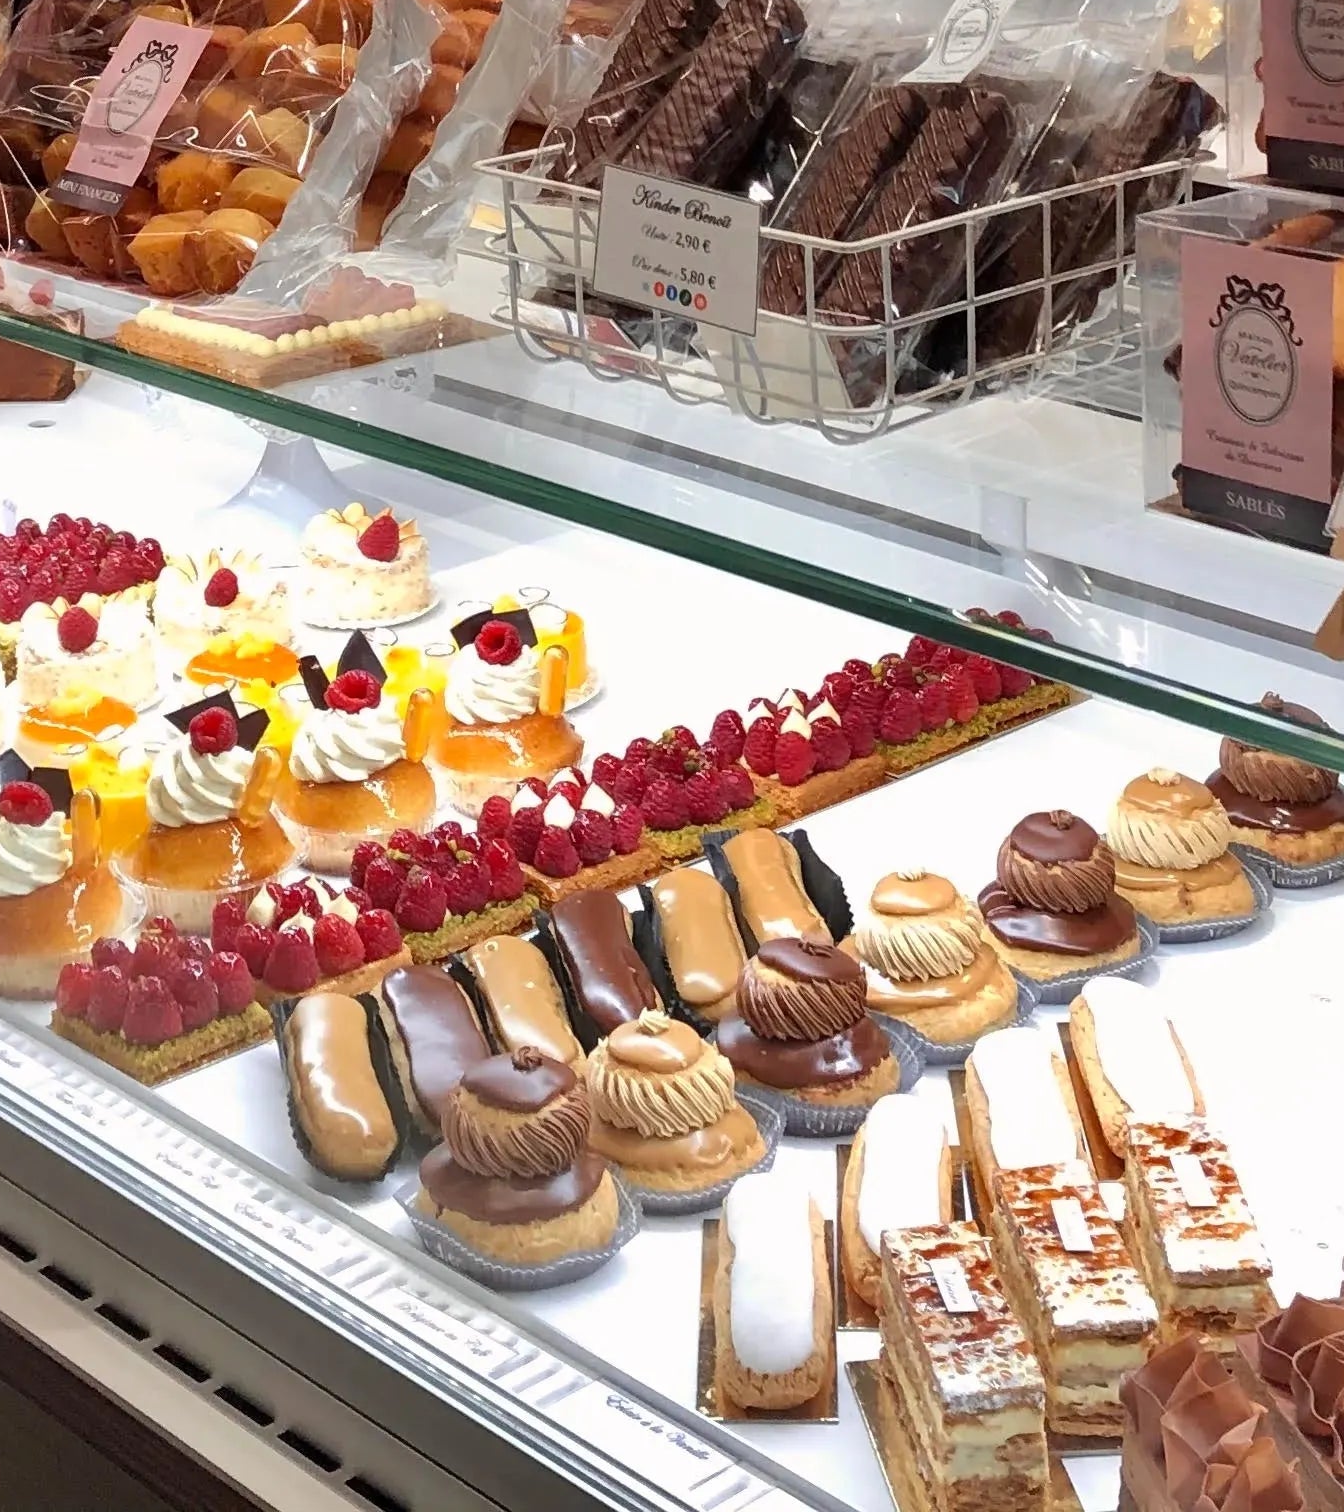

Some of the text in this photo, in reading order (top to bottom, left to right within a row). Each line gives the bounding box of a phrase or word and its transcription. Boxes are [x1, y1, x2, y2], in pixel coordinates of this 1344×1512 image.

[632, 184, 681, 215] Kinder
[675, 231, 700, 250] 2,90
[702, 239, 711, 254] €
[680, 267, 705, 286] 5,80
[708, 275, 717, 290] €
[1222, 340, 1288, 374] Vatelier
[1225, 489, 1287, 521] SABLÉS
